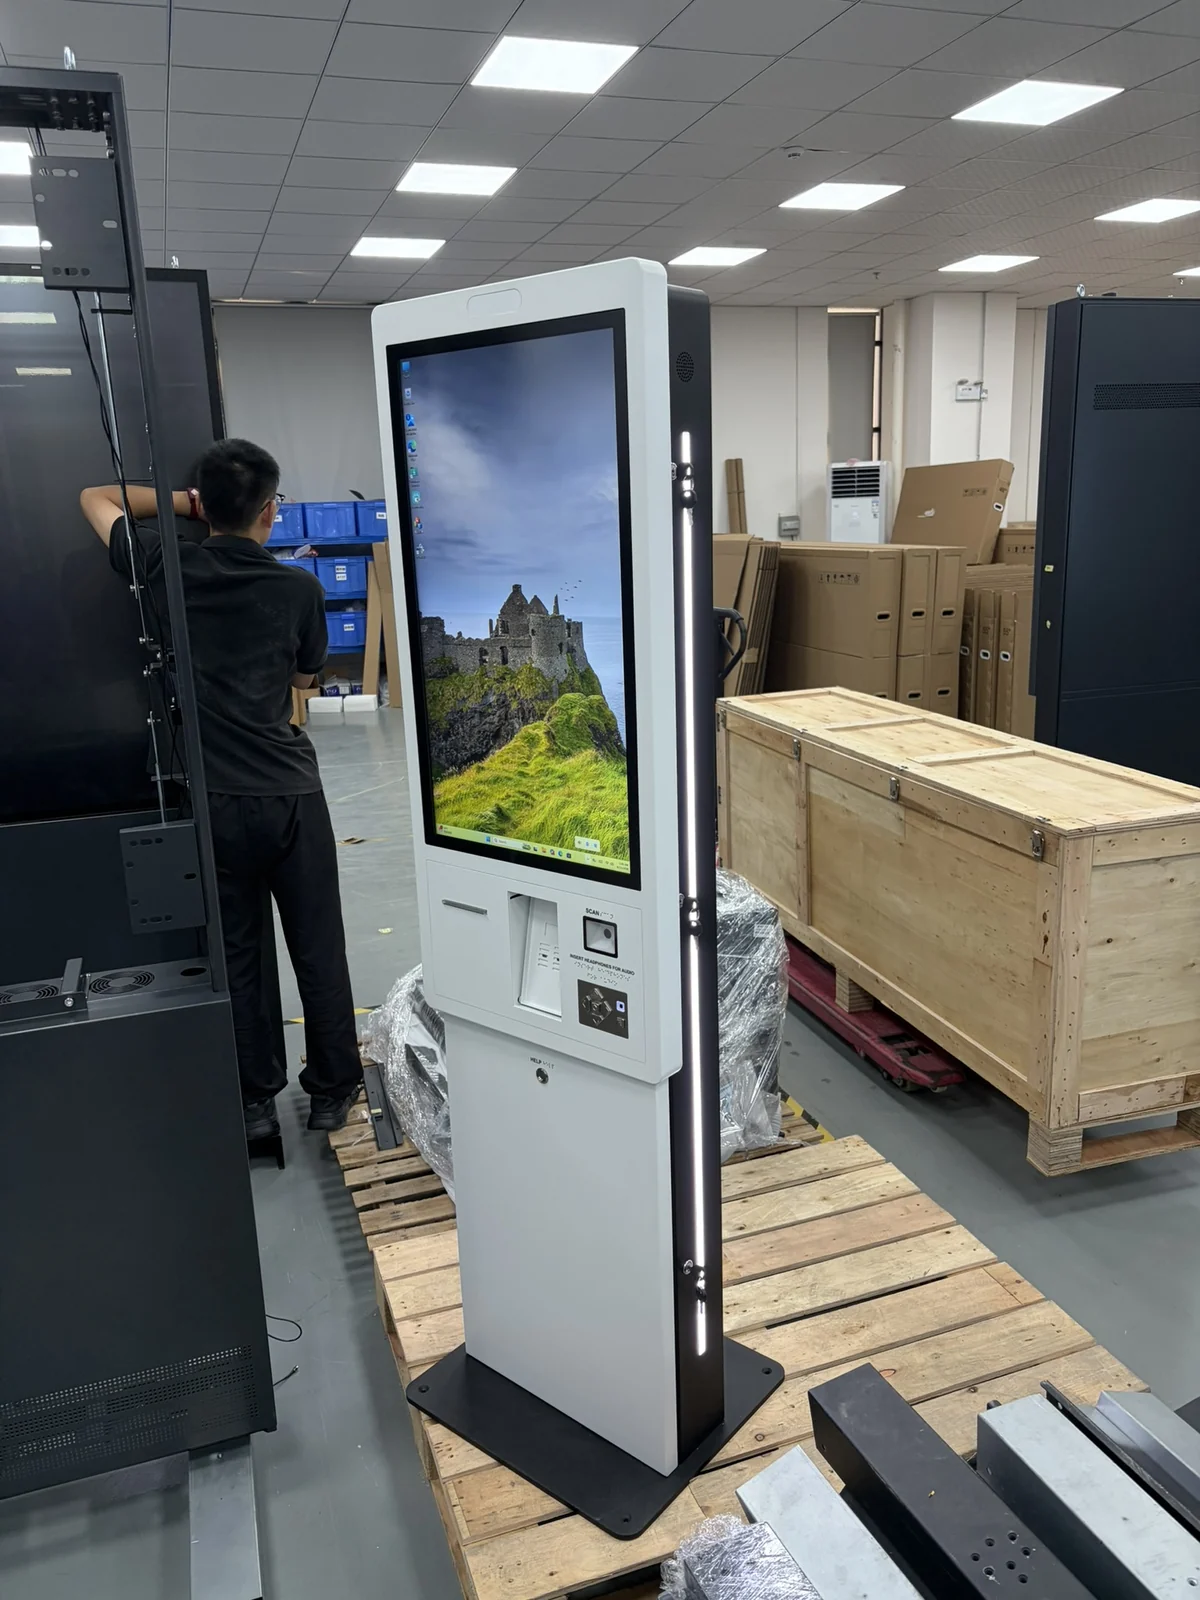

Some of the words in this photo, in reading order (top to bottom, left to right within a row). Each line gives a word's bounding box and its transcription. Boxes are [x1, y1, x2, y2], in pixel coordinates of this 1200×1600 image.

[585, 907, 600, 916] SCAN
[570, 953, 584, 961] INSERT
[584, 958, 612, 970] HEADPHONES
[622, 968, 635, 976] AUDIO
[530, 1056, 542, 1065] HELP
